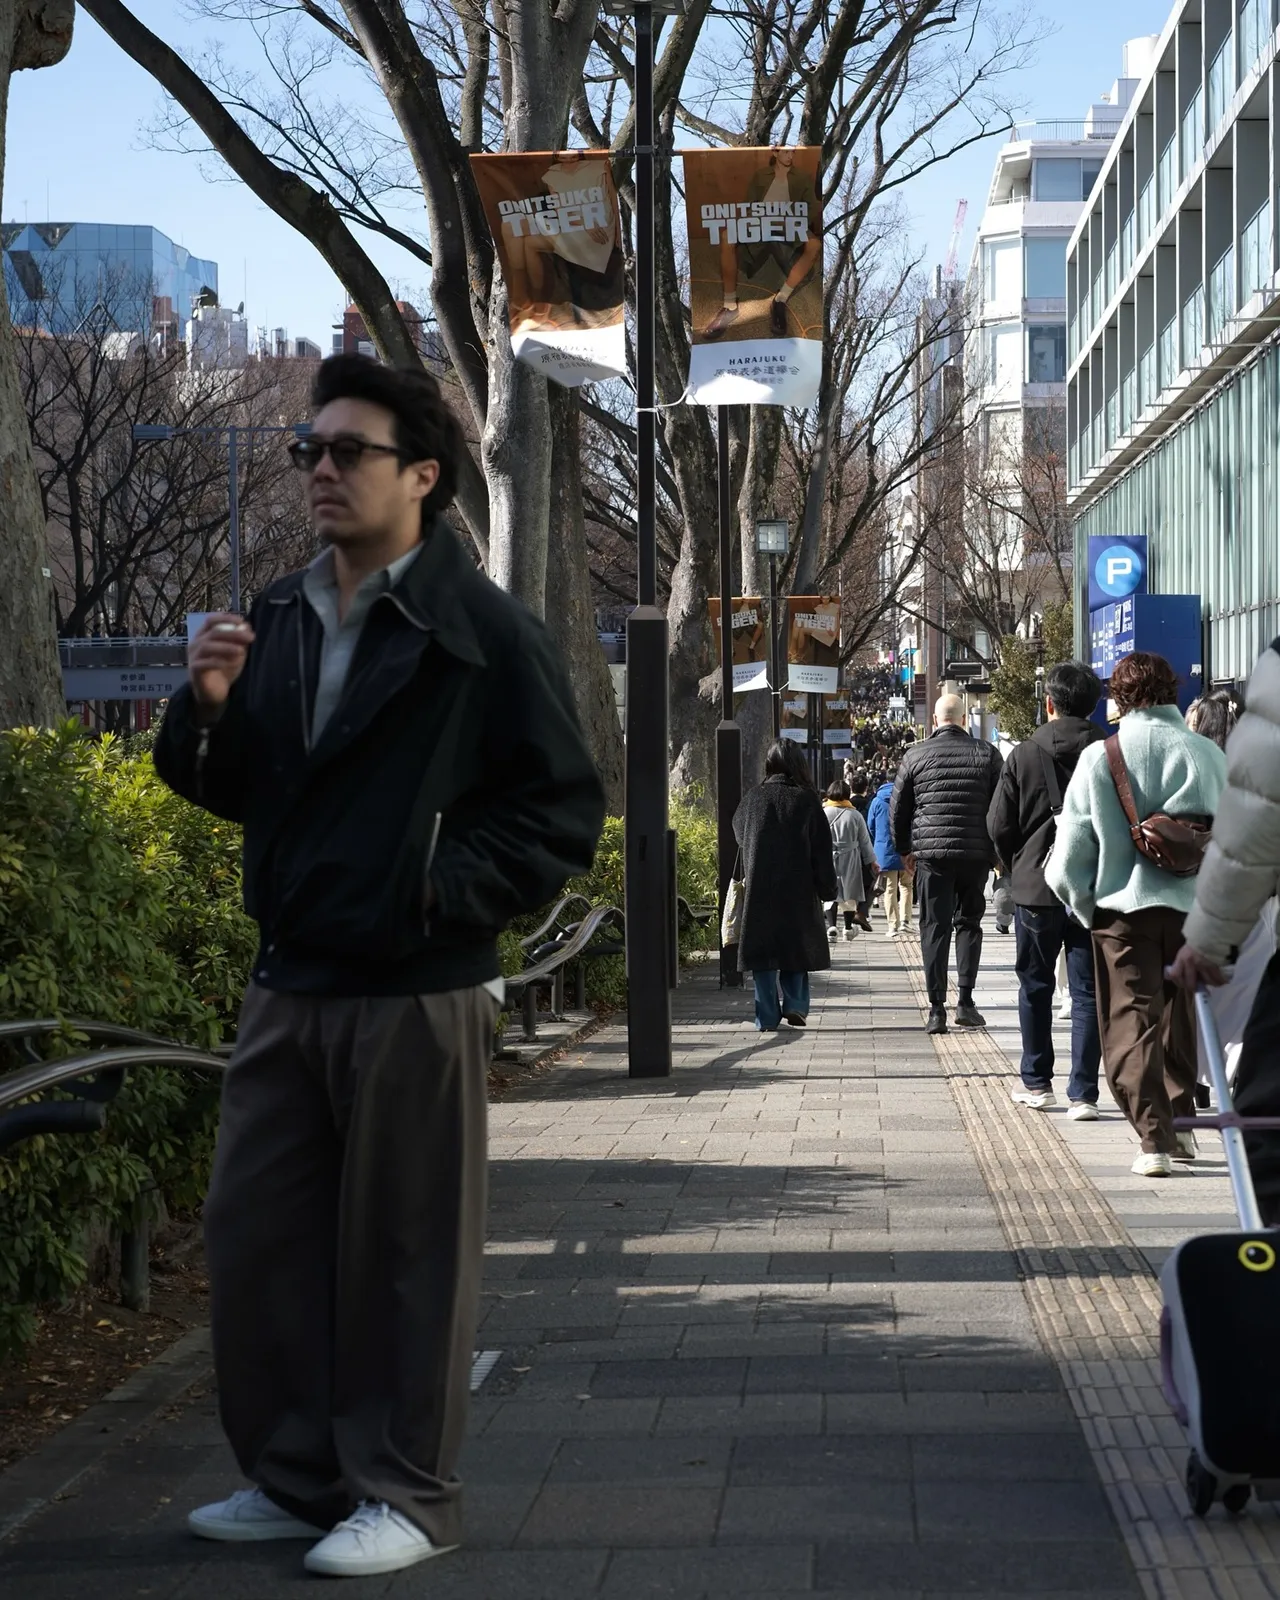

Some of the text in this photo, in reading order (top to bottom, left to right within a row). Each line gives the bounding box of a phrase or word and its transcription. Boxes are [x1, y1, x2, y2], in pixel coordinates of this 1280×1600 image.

[498, 187, 603, 215] ONITSUKA
[701, 201, 808, 219] ONITSUKA
[502, 202, 608, 237] TIGER
[702, 216, 808, 245] TIGER
[729, 355, 786, 365] HARAJUKU
[1107, 558, 1132, 584] P
[796, 618, 835, 631] TIGER
